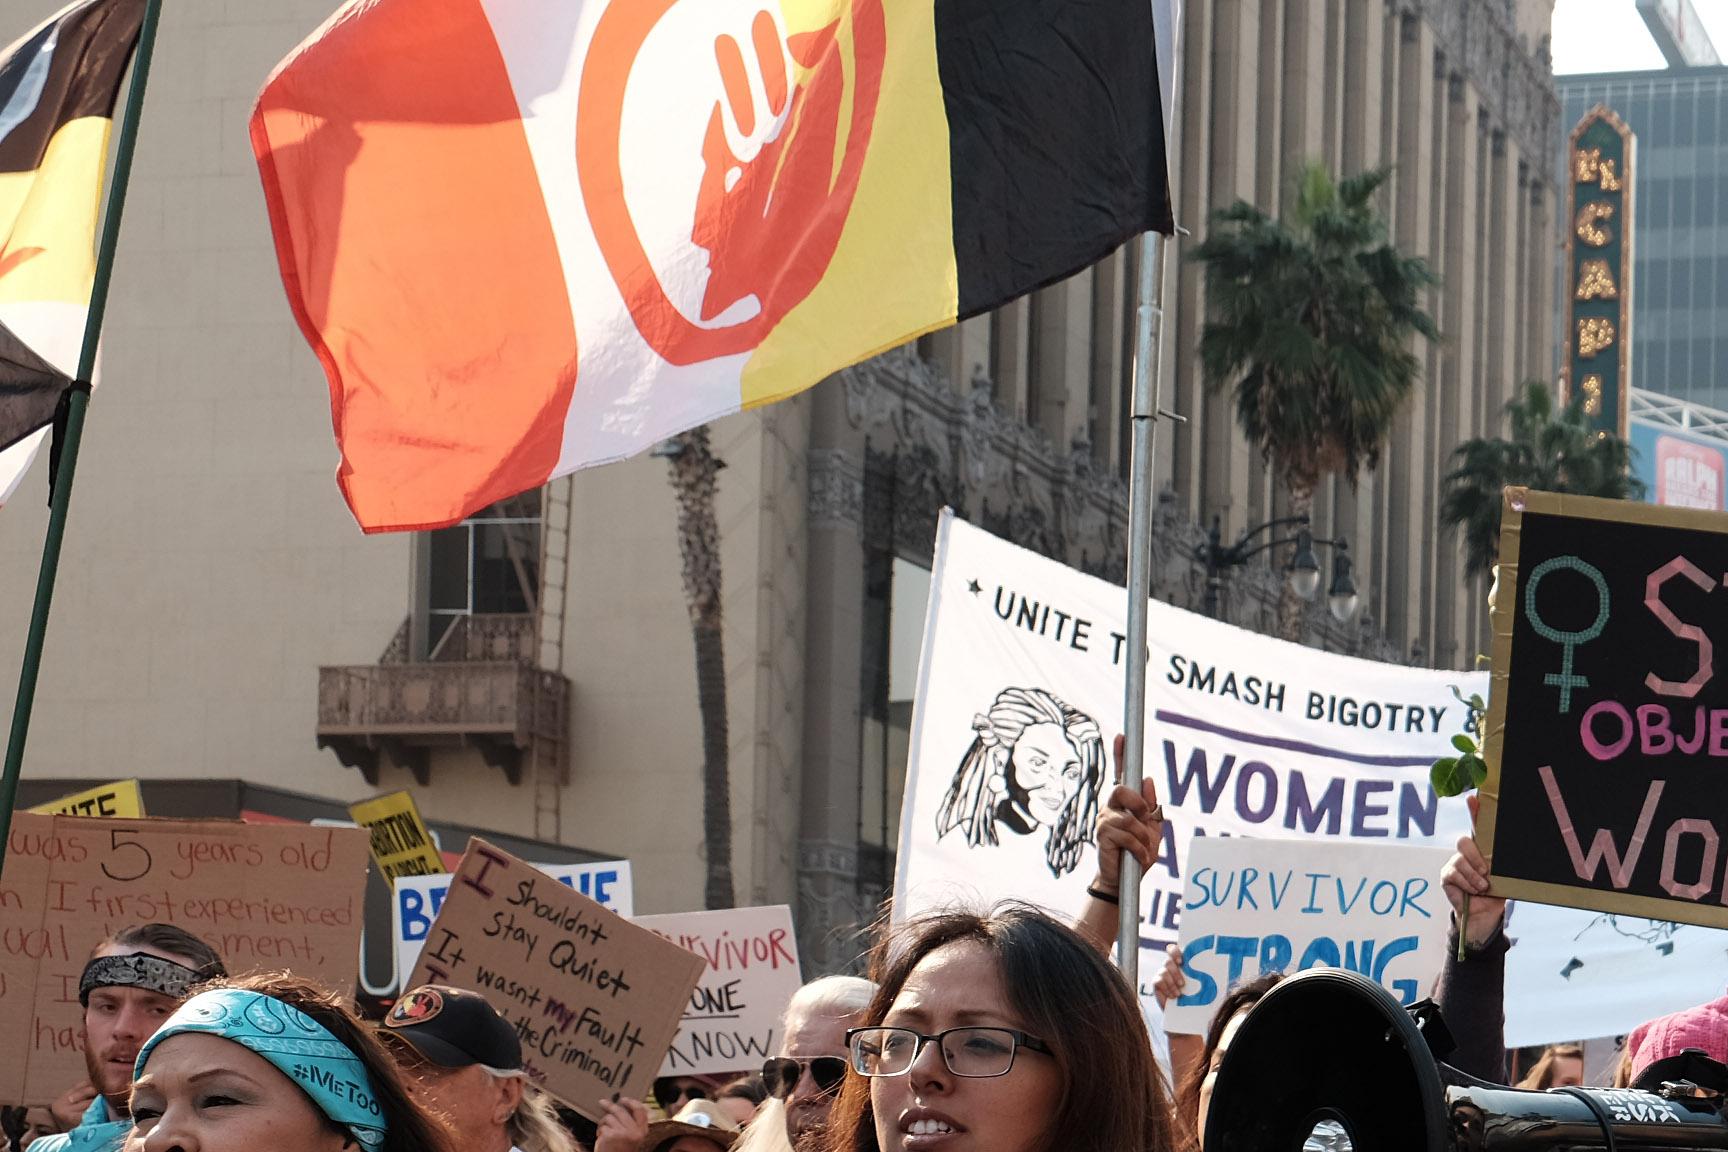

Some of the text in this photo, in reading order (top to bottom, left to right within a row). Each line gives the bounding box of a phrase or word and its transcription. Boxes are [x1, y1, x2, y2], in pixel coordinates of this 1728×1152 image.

[1575, 202, 1618, 446] CAPI
[993, 585, 1092, 653] UNITE
[1109, 631, 1150, 666] T
[1166, 653, 1286, 713] SMASH
[1305, 690, 1447, 734] BIGOTRY
[1161, 738, 1438, 839] WOMEN
[10, 828, 334, 881] was 5 years old
[461, 846, 510, 901] I
[50, 880, 78, 912] I
[87, 886, 180, 921] first
[184, 895, 352, 927] experienced
[1185, 865, 1432, 920] SURVIVOR
[427, 928, 466, 969] It
[574, 1007, 645, 1059] Fault
[549, 940, 630, 999] Quiet
[1176, 933, 1419, 1008] STRONG
